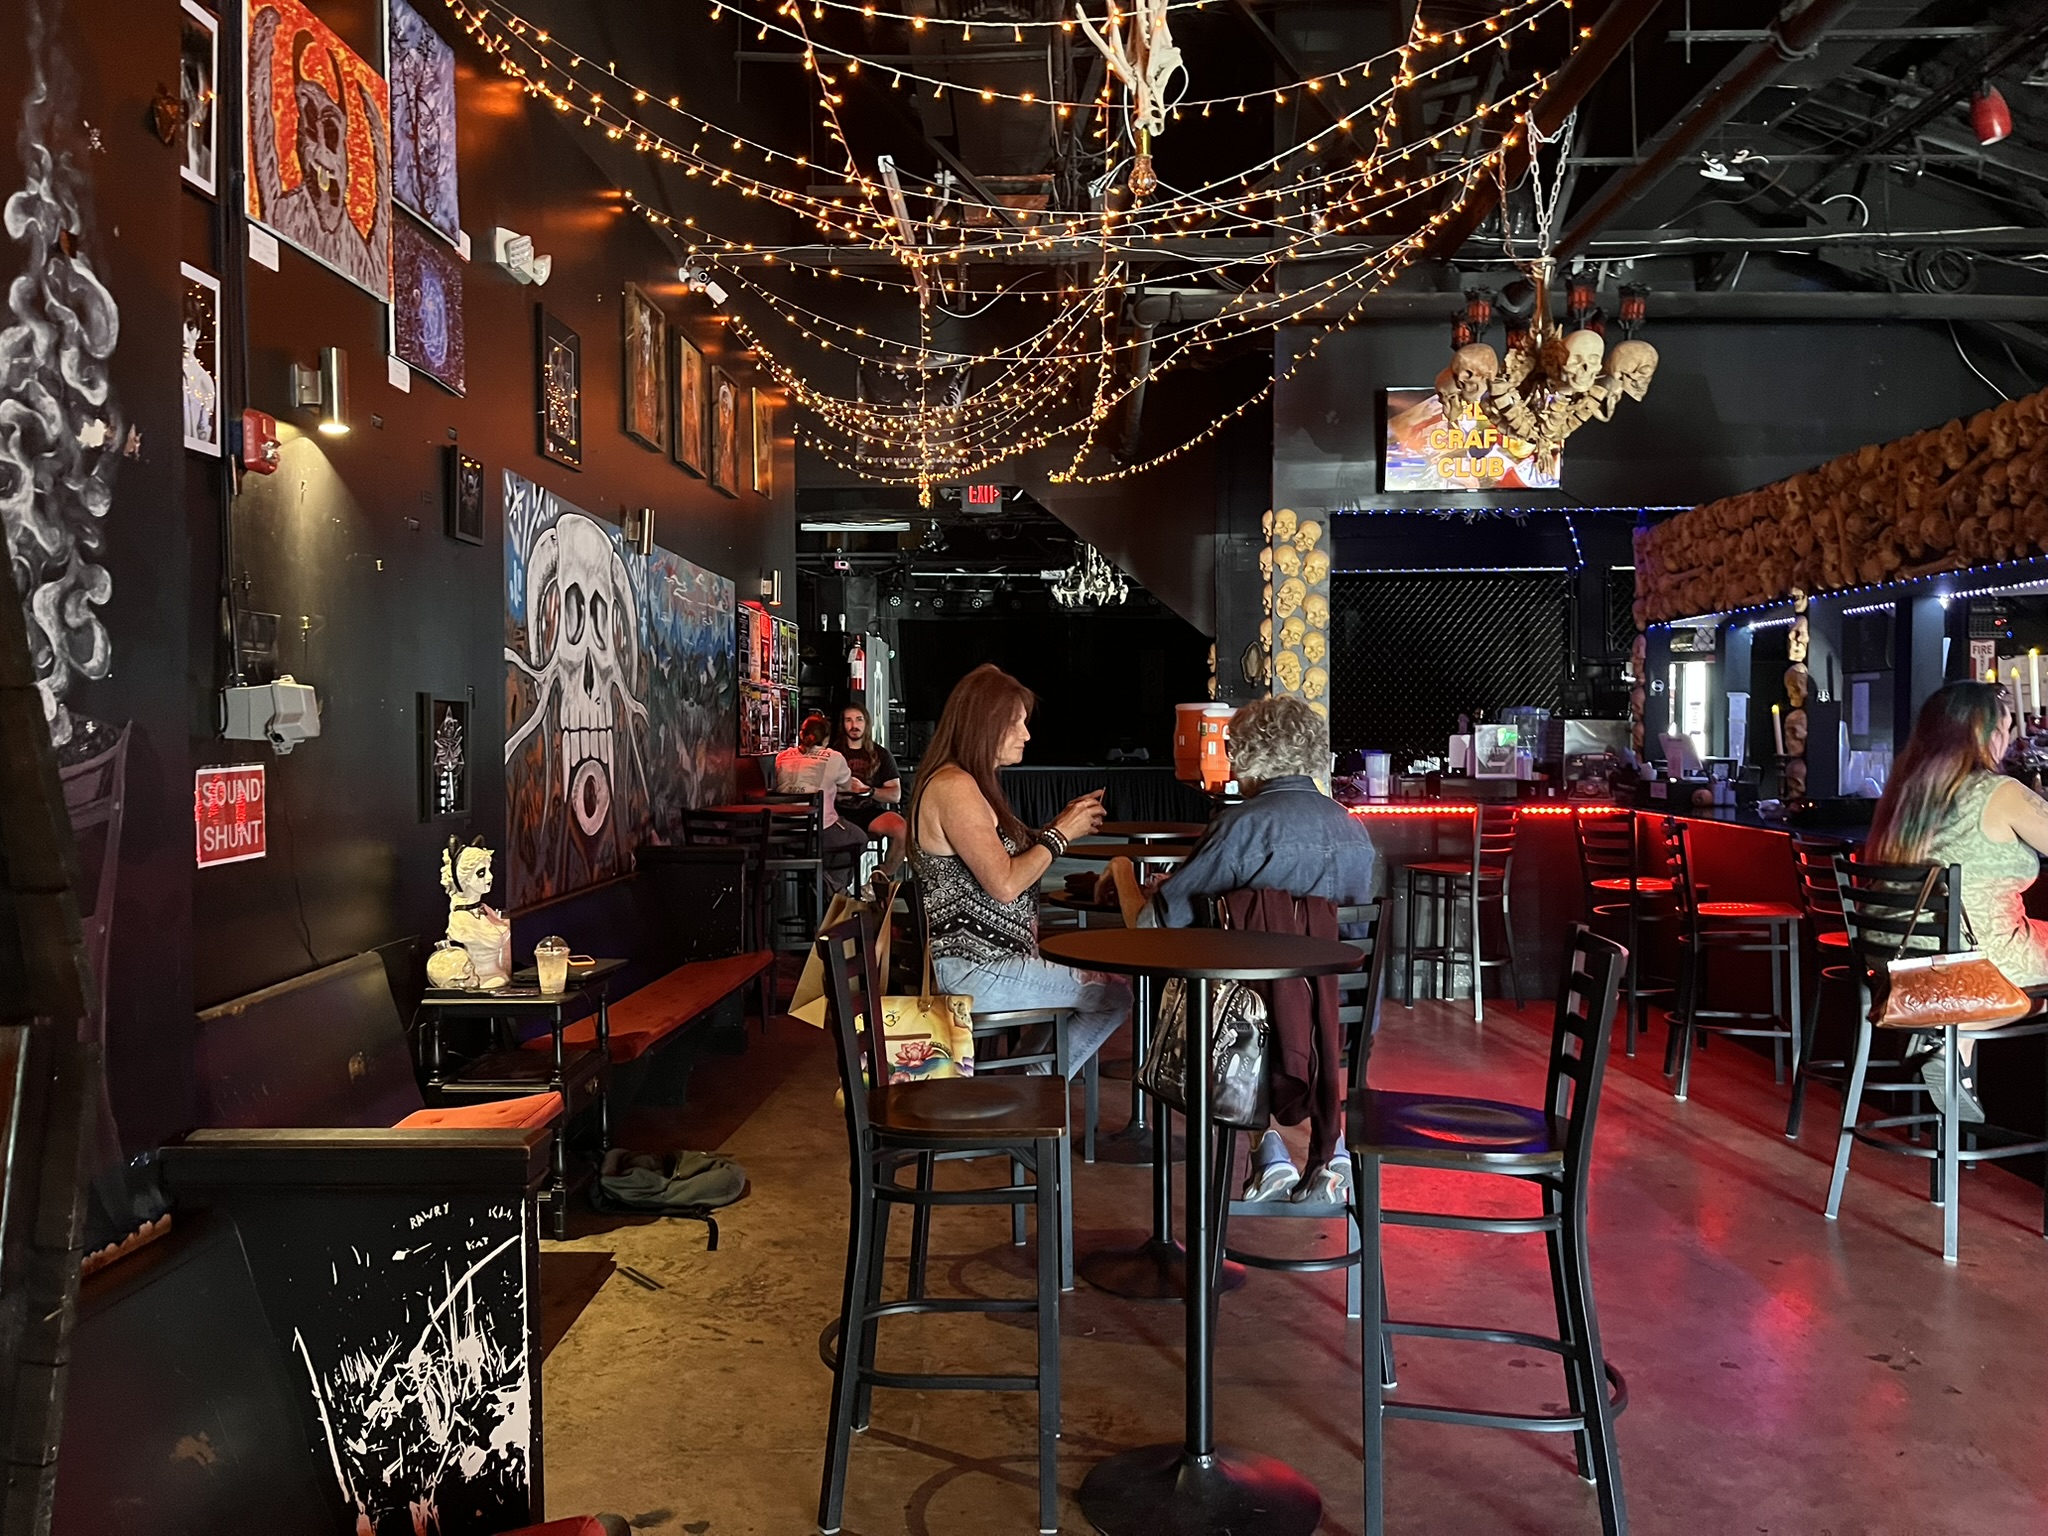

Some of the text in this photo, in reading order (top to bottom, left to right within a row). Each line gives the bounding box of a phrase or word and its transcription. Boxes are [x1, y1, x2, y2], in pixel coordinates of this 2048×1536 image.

[1437, 456, 1504, 478] CLUB
[968, 485, 995, 504] EXIT
[1972, 644, 1993, 655] FIRE
[202, 778, 261, 807] SOUND
[203, 820, 262, 852] SHUNT
